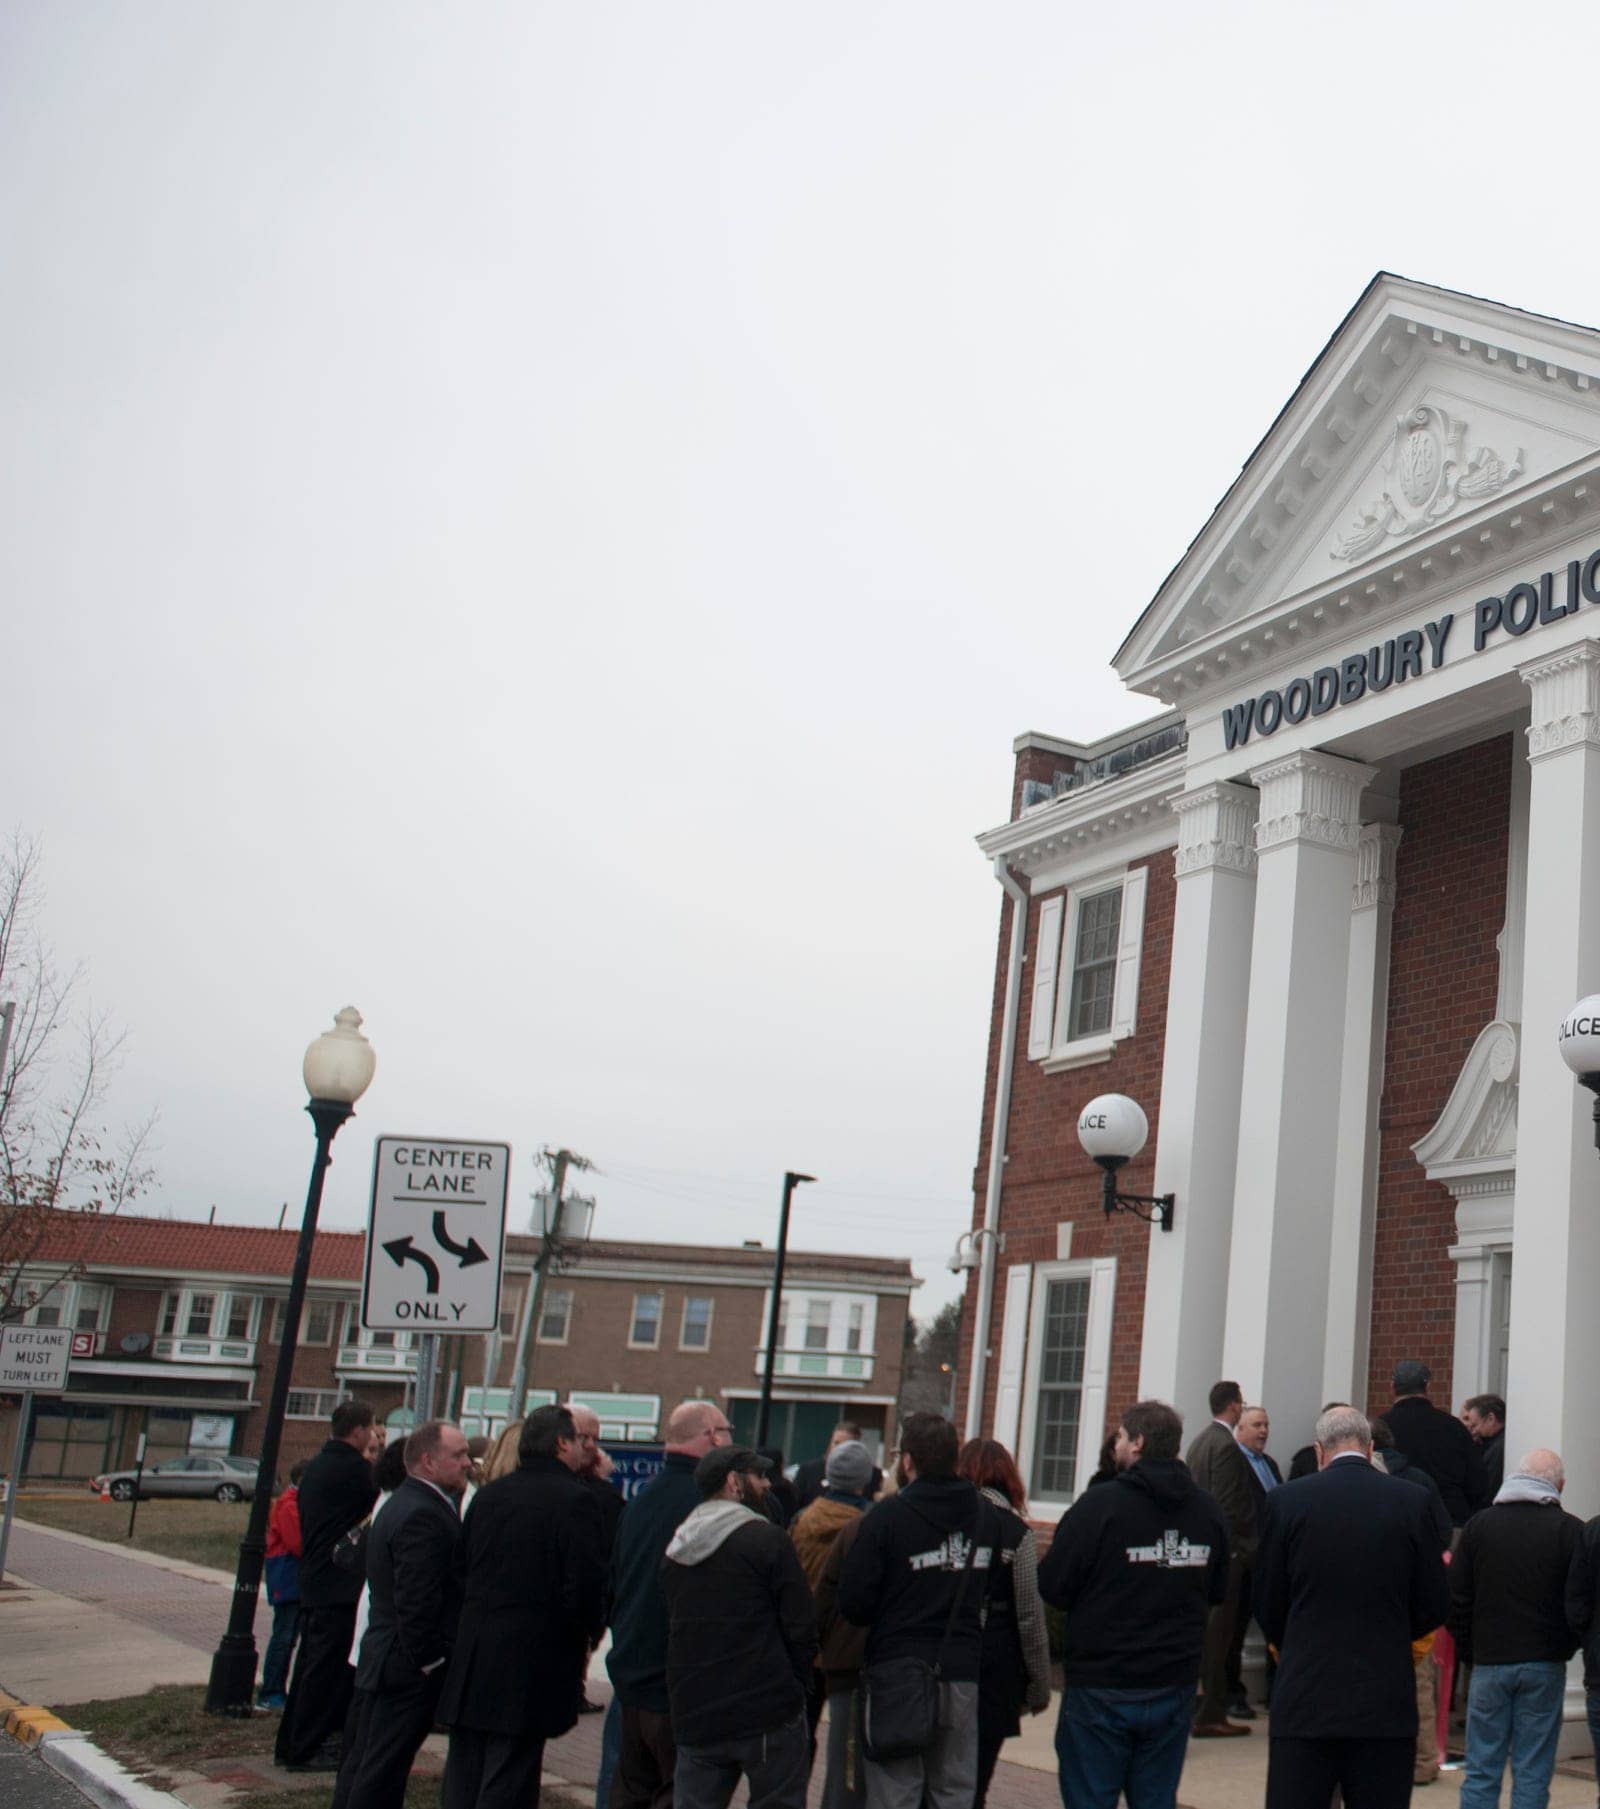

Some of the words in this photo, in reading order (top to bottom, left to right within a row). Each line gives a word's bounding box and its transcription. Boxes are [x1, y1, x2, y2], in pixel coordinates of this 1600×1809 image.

[1222, 614, 1455, 751] WOODBURY
[393, 1146, 493, 1170] CENTER
[407, 1172, 476, 1193] LANE
[395, 1300, 467, 1321] ONLY
[9, 1333, 35, 1344] LEFT
[37, 1335, 65, 1345] LANE
[15, 1351, 52, 1364] MUST
[3, 1370, 31, 1381] TURN
[33, 1372, 59, 1381] LEFT
